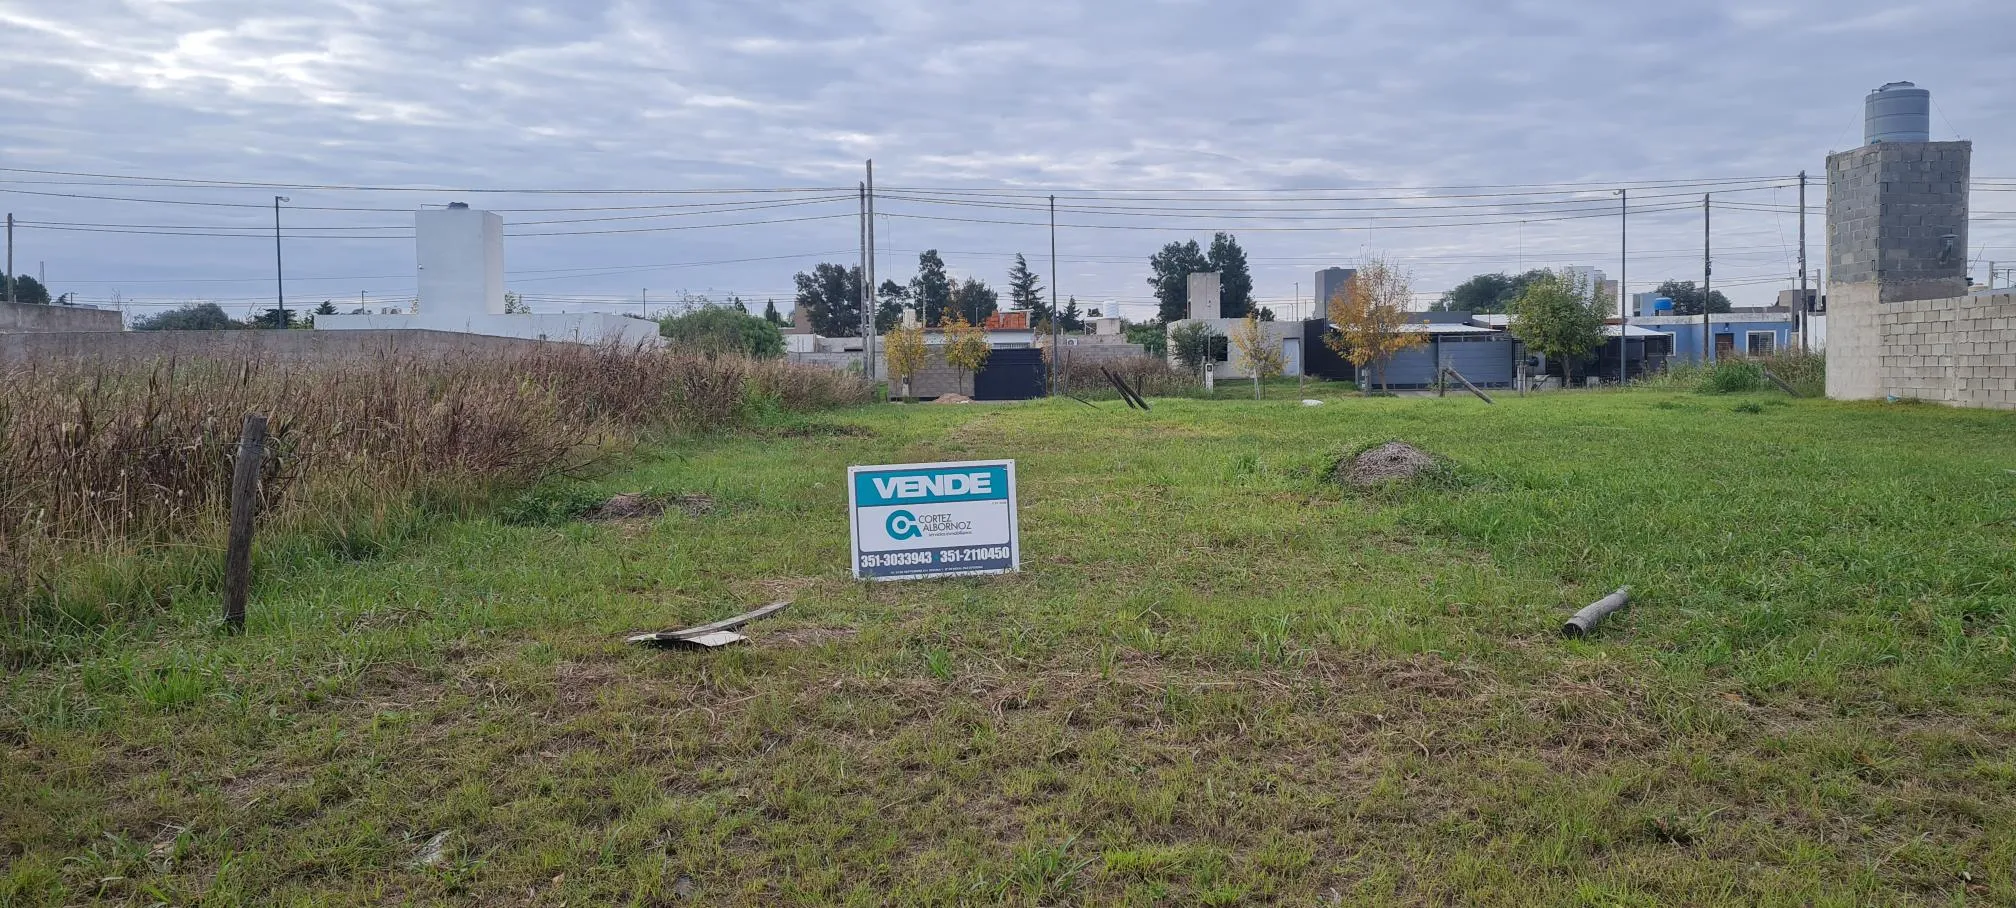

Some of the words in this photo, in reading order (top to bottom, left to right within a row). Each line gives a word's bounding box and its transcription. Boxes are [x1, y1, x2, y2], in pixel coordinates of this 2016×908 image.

[872, 472, 992, 499] VENDE
[918, 513, 952, 524] CORTEZ
[922, 521, 972, 532] ALBORNOZ
[861, 551, 932, 568] 351-3033943
[940, 546, 1010, 563] 351-2110450
